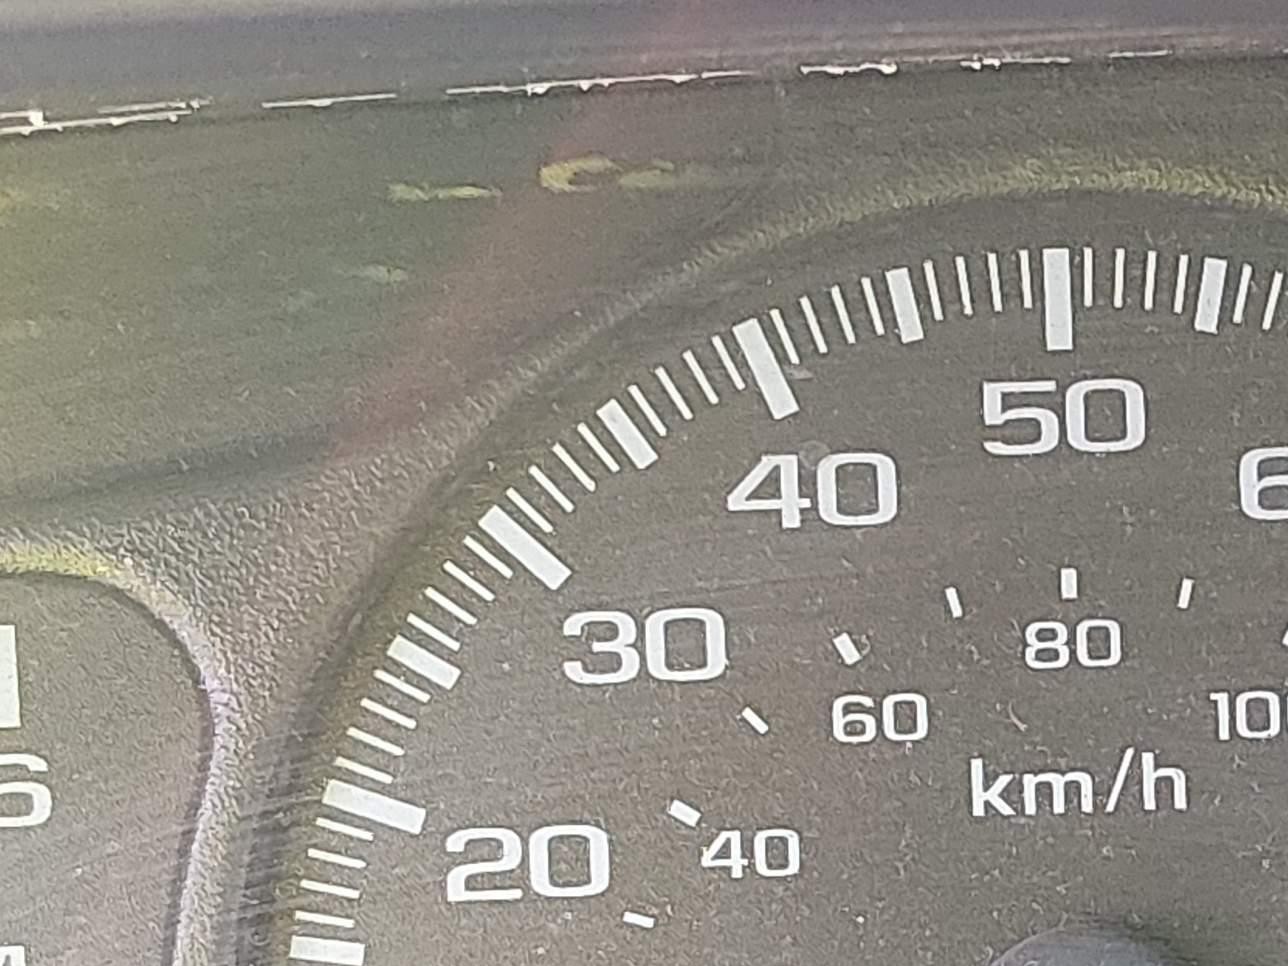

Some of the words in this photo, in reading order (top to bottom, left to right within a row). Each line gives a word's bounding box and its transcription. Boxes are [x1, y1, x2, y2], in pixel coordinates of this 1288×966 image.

[983, 378, 1146, 455] 50
[727, 452, 898, 529] 40
[563, 607, 729, 685] 30
[1025, 619, 1122, 669] 80
[832, 693, 929, 744] 60
[970, 747, 1187, 817] km/h
[445, 824, 610, 902] 20
[701, 828, 800, 879] 40
